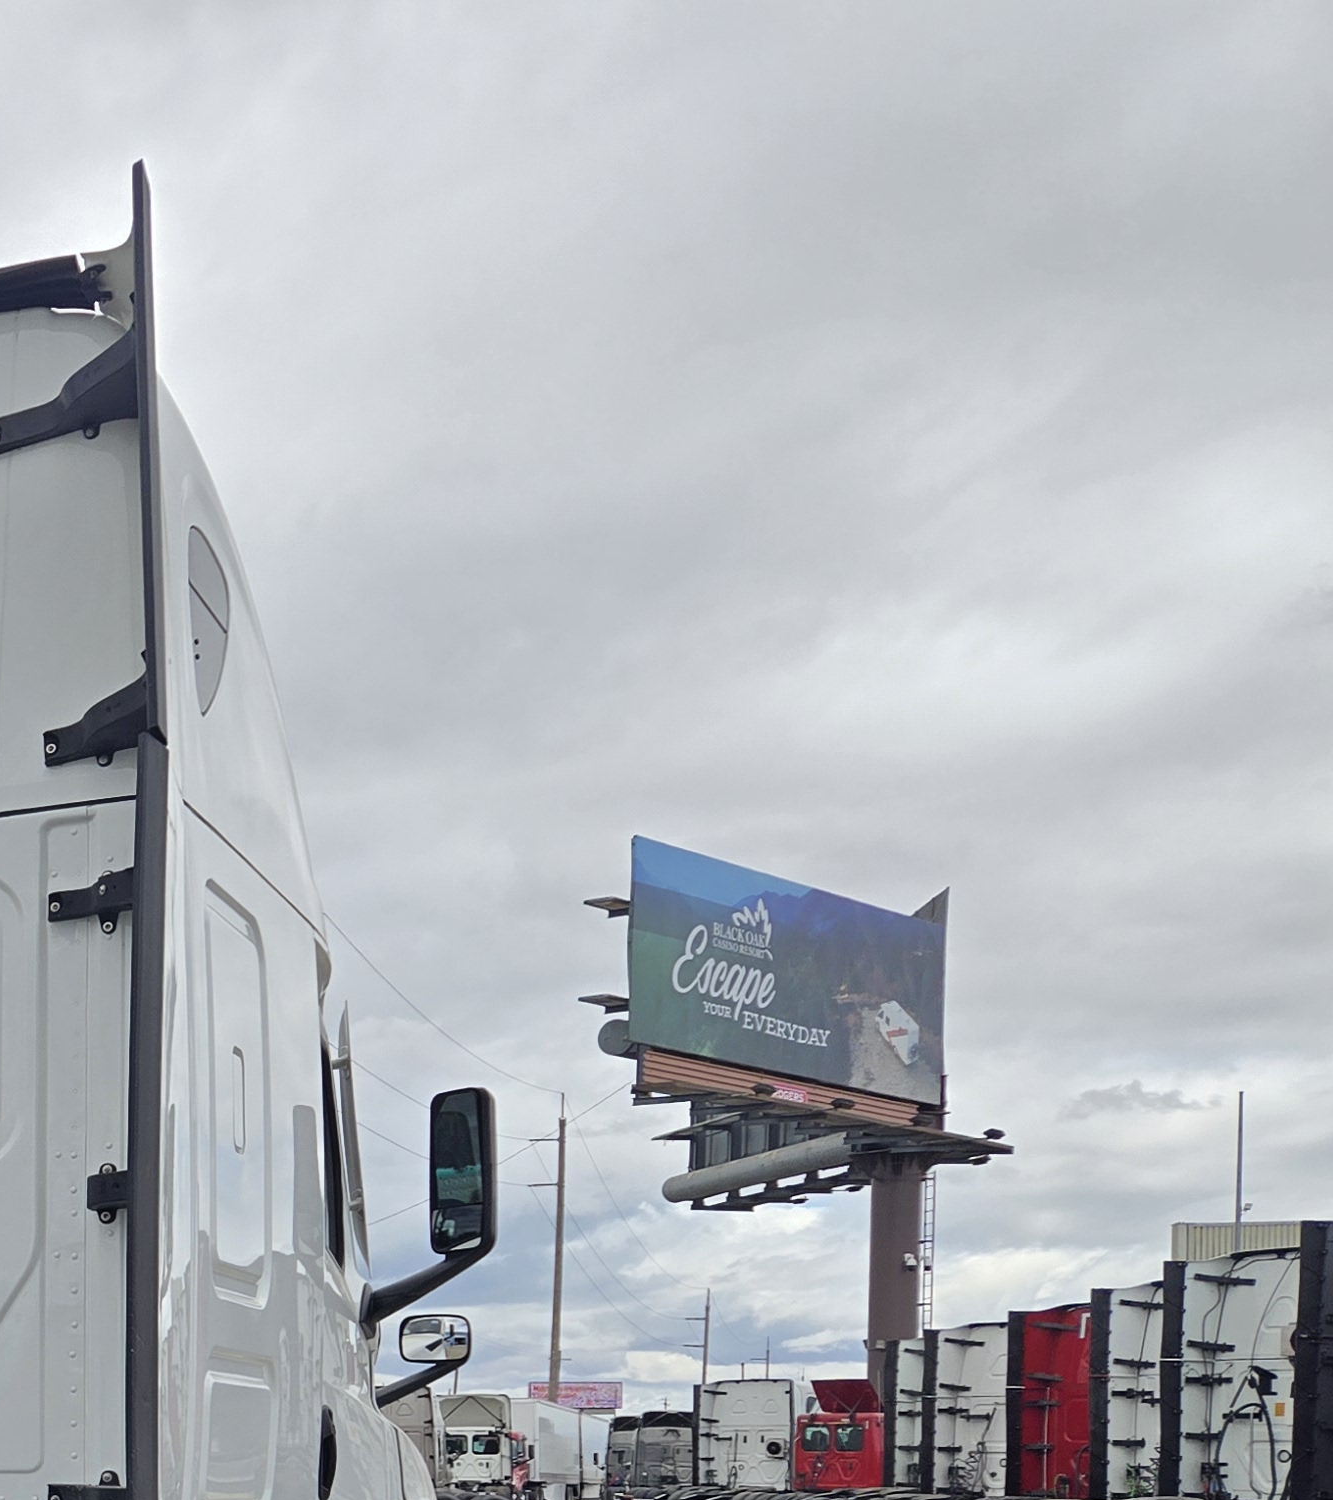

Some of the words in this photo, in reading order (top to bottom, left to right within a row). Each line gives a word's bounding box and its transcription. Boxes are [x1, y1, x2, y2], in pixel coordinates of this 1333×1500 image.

[713, 922, 744, 942] BLACK
[745, 930, 766, 948] OAK
[672, 924, 776, 1021] Escape
[703, 1001, 732, 1019] YOUR
[742, 1011, 831, 1047] EVERYDAY
